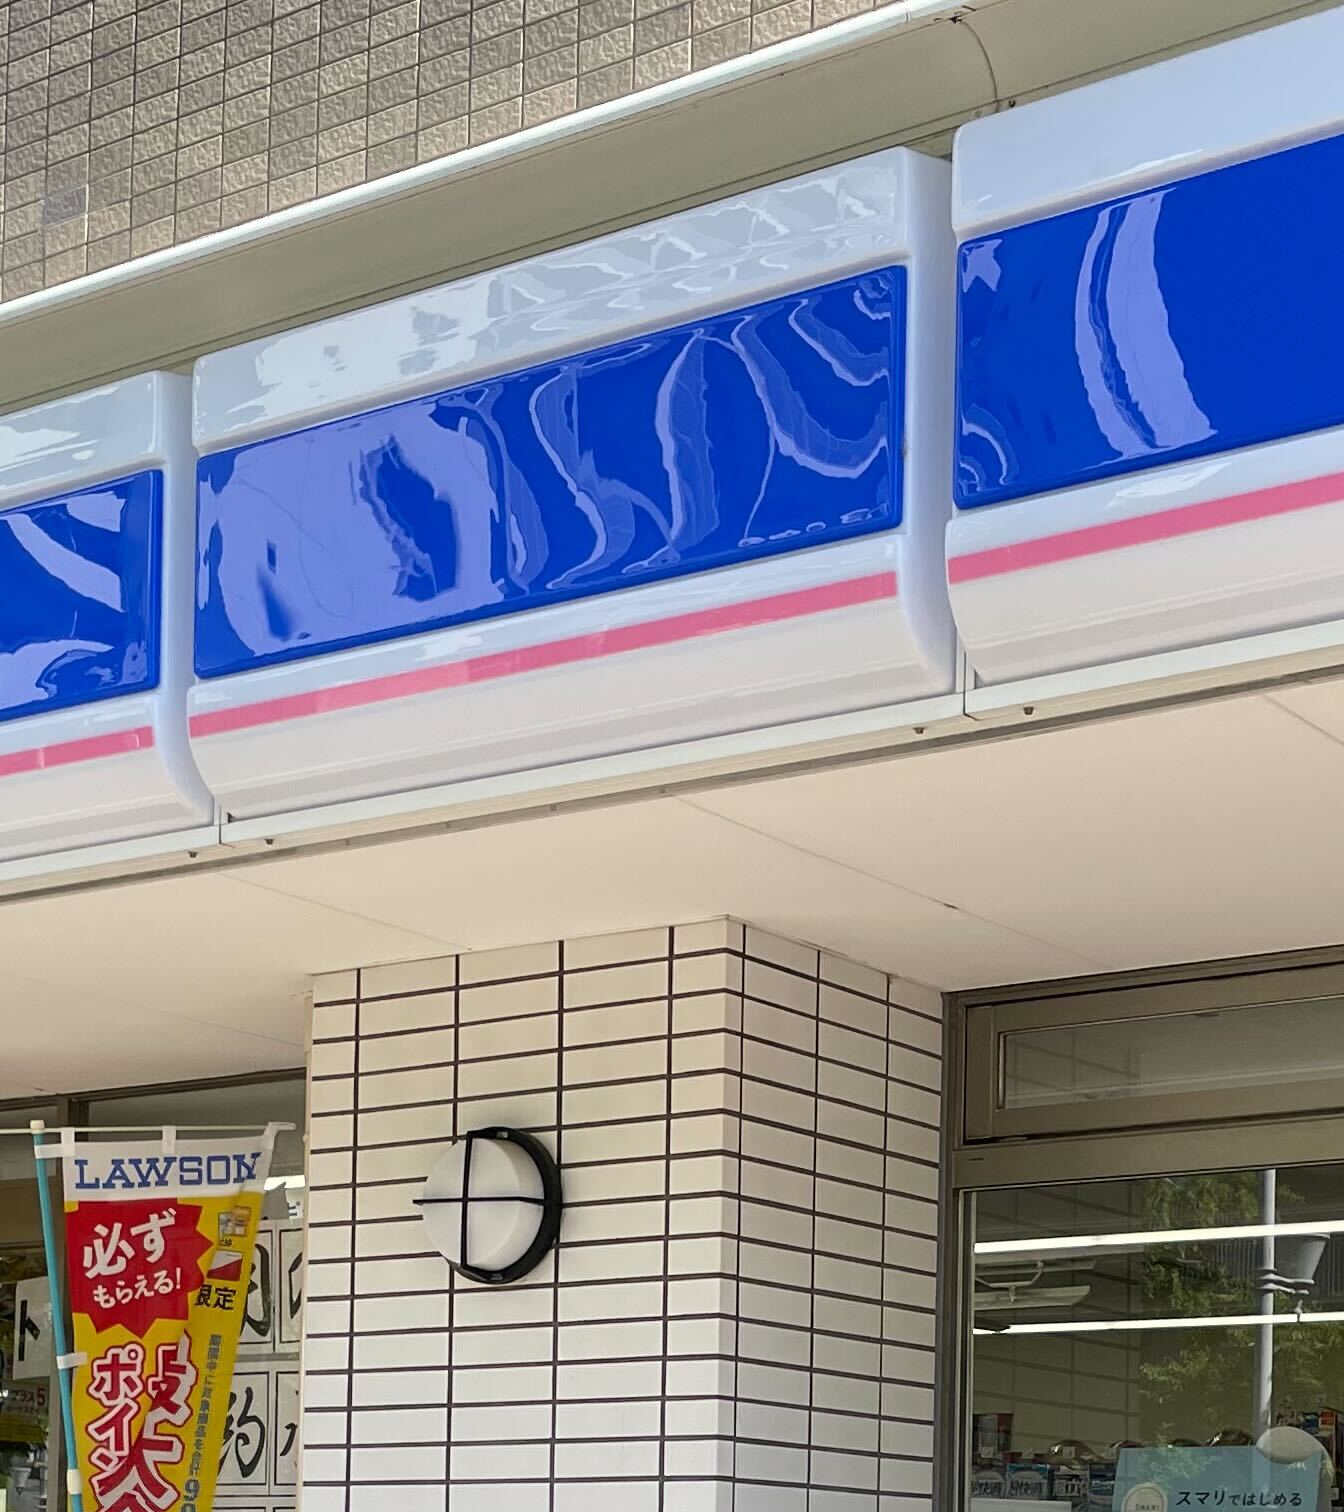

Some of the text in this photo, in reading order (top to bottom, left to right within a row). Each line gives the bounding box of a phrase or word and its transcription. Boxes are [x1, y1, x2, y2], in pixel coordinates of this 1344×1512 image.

[74, 1151, 262, 1189] LAWSON
[83, 1207, 178, 1280] 必ず
[92, 1267, 181, 1309] もらえる!
[1175, 1490, 1303, 1507] スマリではじめる
